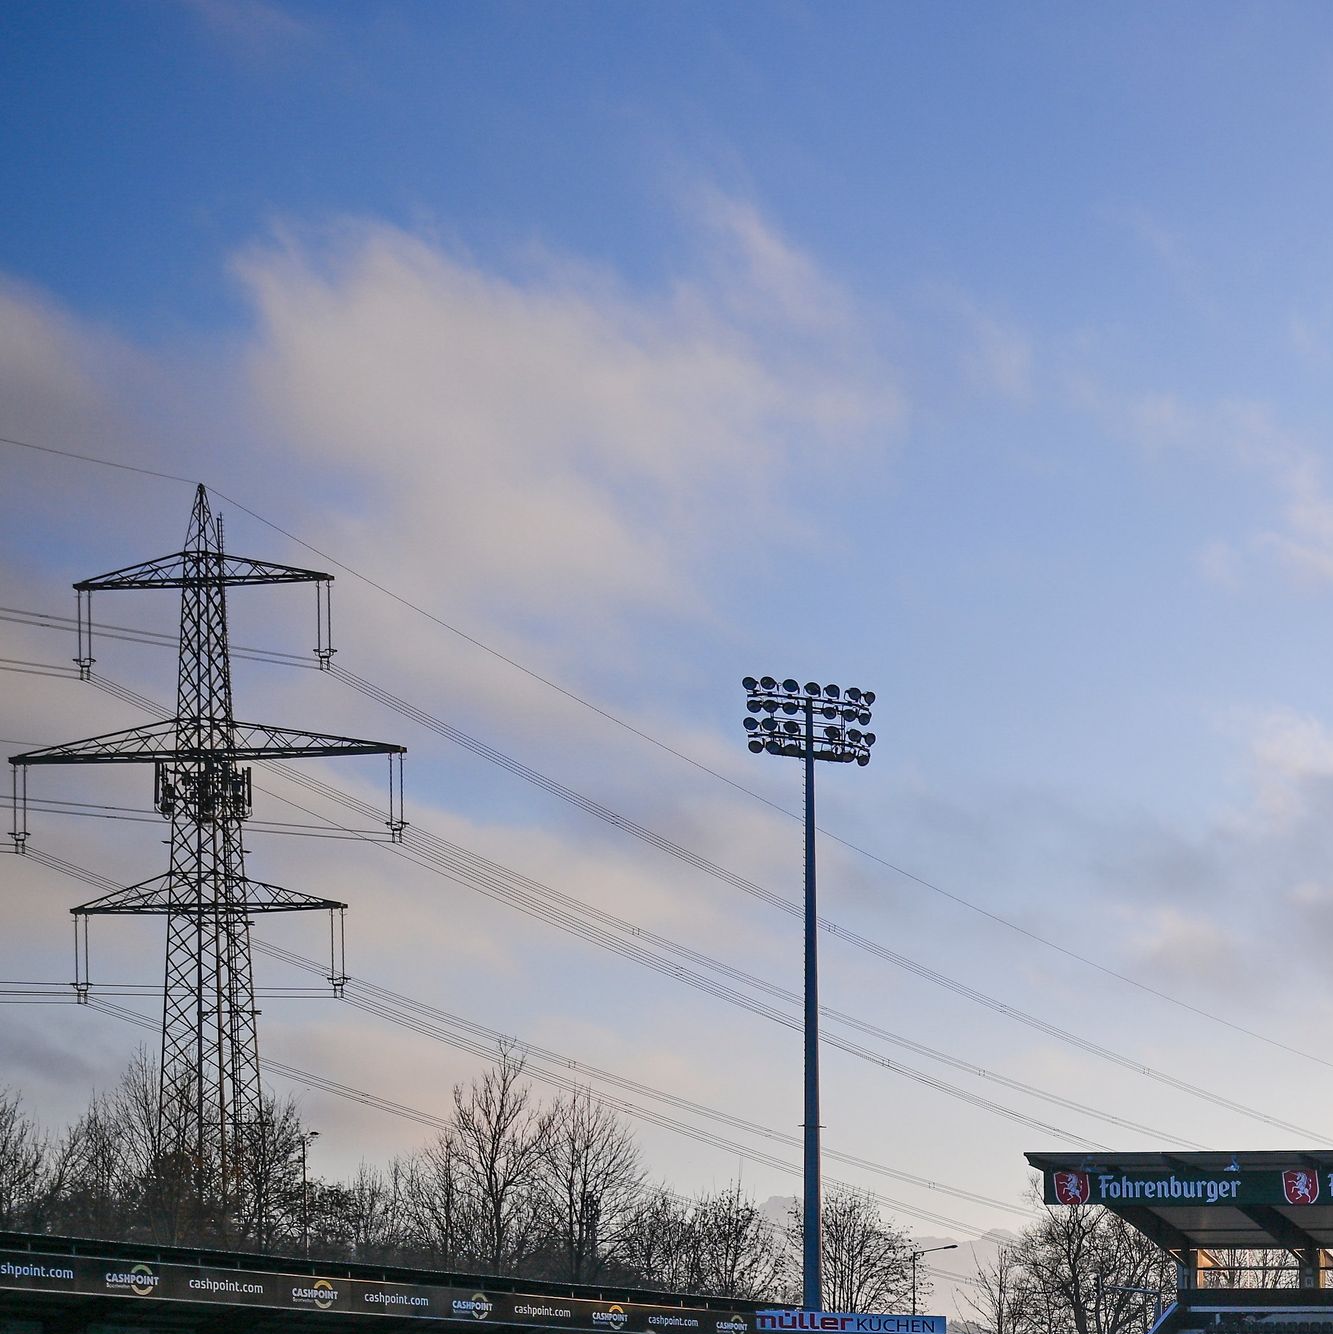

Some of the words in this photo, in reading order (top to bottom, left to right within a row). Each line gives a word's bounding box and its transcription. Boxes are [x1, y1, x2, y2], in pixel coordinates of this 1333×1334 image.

[1098, 1175, 1242, 1203] Fohrenburger
[106, 1273, 159, 1285] CASHPOINT
[189, 1278, 263, 1294] cashpoint.com
[292, 1288, 338, 1300] CASHPOINT
[364, 1292, 429, 1306] cashpoint.com
[452, 1300, 493, 1312] CASHPOINT
[514, 1304, 571, 1318] cashpoint.com
[592, 1312, 628, 1322] CASHPOINT
[648, 1315, 699, 1328] cashpoint.com
[757, 1313, 853, 1330] müller
[857, 1315, 935, 1333] KÜCHEN
[716, 1320, 748, 1332] CASHPOINT
